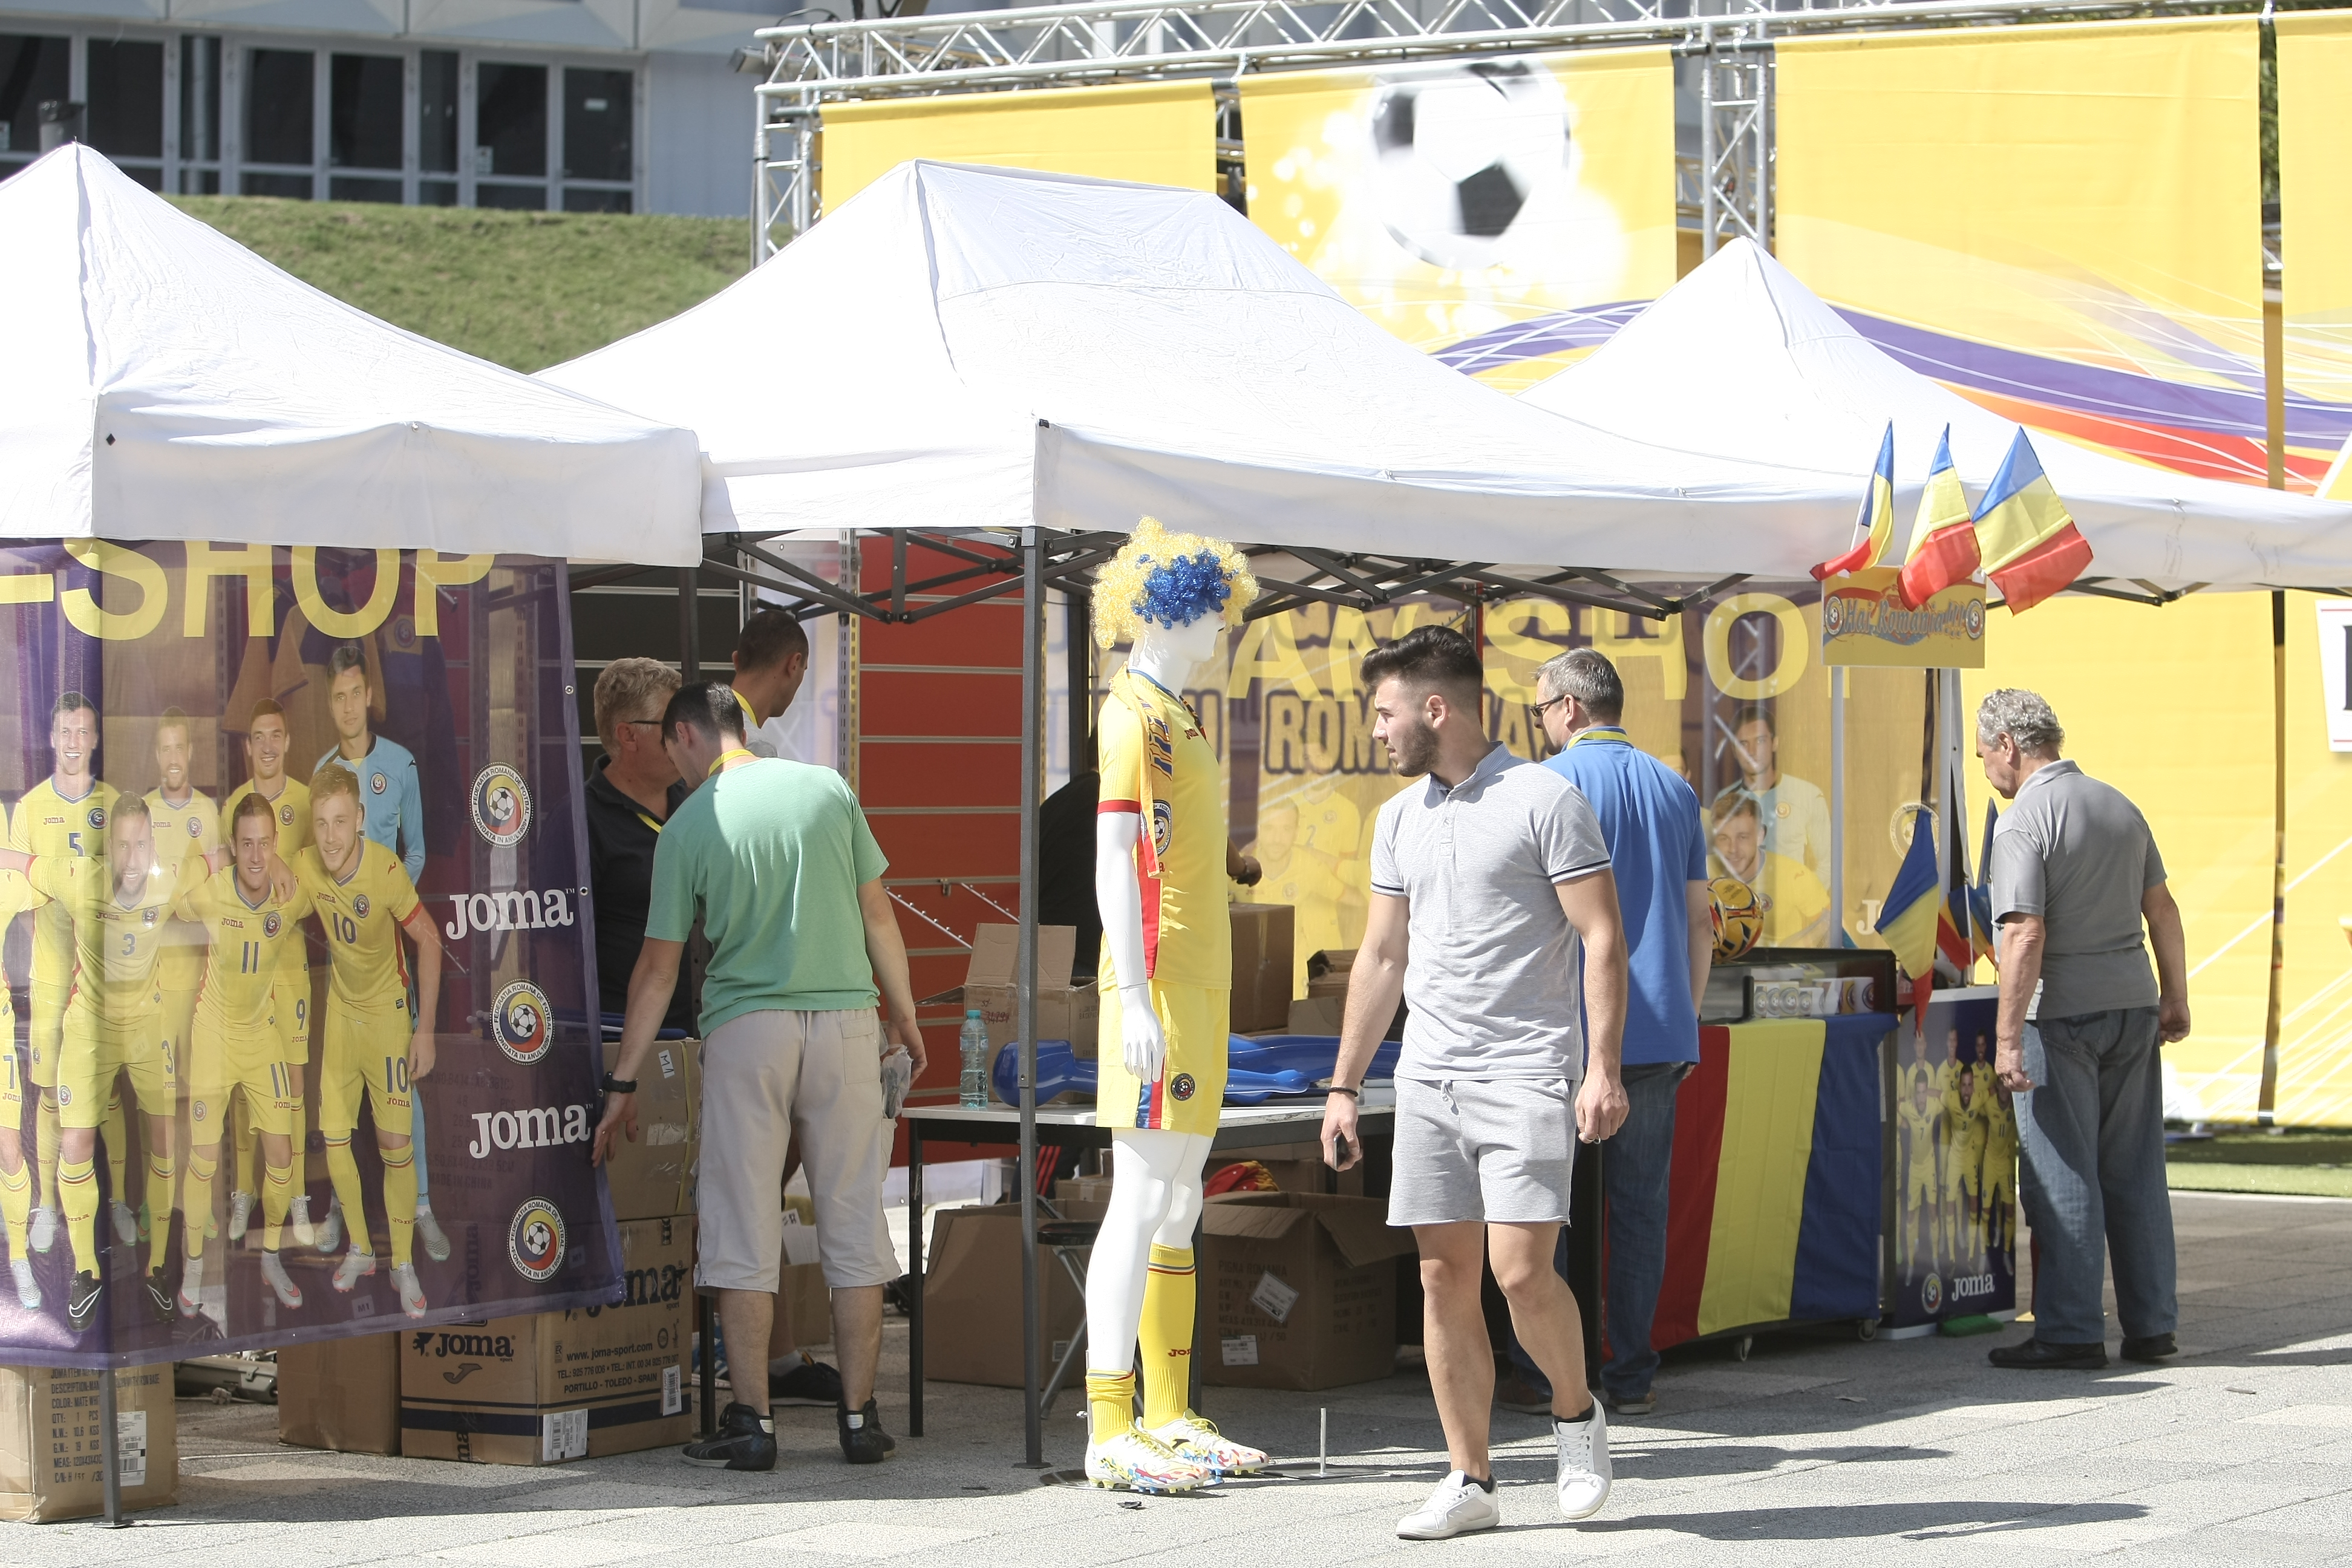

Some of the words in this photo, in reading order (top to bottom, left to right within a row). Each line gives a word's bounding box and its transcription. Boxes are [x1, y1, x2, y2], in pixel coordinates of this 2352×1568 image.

[473, 771, 490, 805] FEDERATIA
[490, 766, 515, 780] ROMANA
[515, 777, 523, 786] DE
[474, 812, 495, 840] FONDATA
[332, 912, 357, 944] 10
[121, 932, 136, 957] 3
[241, 941, 260, 974] 11
[295, 999, 307, 1031] 9
[494, 989, 512, 1023] FEDERATIA
[512, 984, 537, 995] ROMANA
[537, 993, 544, 1002] DE
[543, 1002, 552, 1031] FOTBAL
[162, 1040, 174, 1074] 3
[496, 1030, 518, 1059] FONDATA
[527, 1050, 542, 1060] ANUL
[3, 1054, 15, 1089] 7
[270, 1061, 291, 1099] 11
[385, 1056, 410, 1094] 10
[528, 1201, 552, 1211] ROMANA
[557, 1218, 566, 1248] FOTBAL
[511, 1249, 532, 1276] FONDATA
[564, 1380, 598, 1394] PORTILLO
[605, 1376, 632, 1389] TOLEDO
[638, 1372, 658, 1383] SPAIN
[572, 1367, 583, 1377] 925
[52, 1397, 73, 1408] COLOR:
[74, 1396, 88, 1407] MATE
[52, 1413, 66, 1423] QTY:
[89, 1410, 99, 1421] PCS
[90, 1425, 100, 1436] KGS
[90, 1439, 100, 1451] KGS
[54, 1457, 72, 1468] MEAS:
